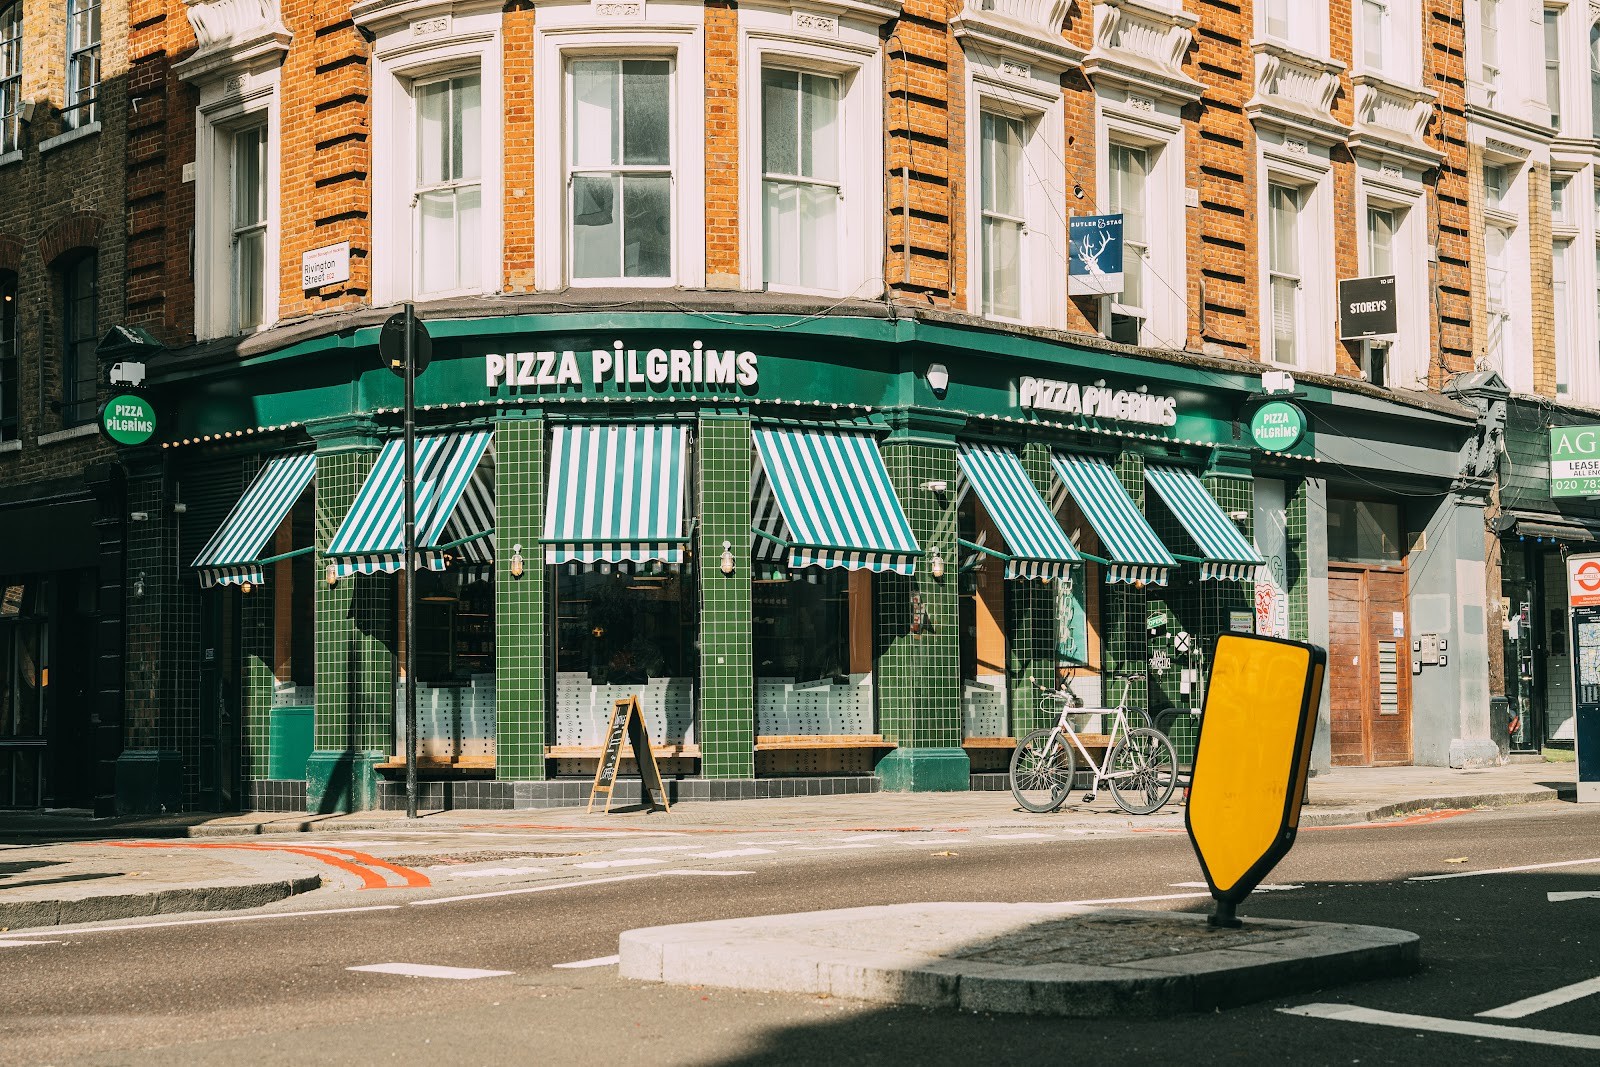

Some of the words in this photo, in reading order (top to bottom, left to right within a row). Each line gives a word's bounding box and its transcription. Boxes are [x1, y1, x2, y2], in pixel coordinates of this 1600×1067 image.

[1097, 218, 1106, 229] &
[1106, 218, 1122, 226] STAG
[304, 260, 336, 273] Rivington
[304, 273, 325, 286] Street
[326, 272, 335, 280] EC2
[1350, 300, 1387, 314] STOREYS
[486, 351, 582, 387] PIZZA
[1019, 376, 1082, 415] PIZZA
[115, 404, 144, 417] PIZZA
[1263, 412, 1289, 425] PIZZA
[1569, 461, 1599, 470] LEASE
[1556, 480, 1578, 490] 020
